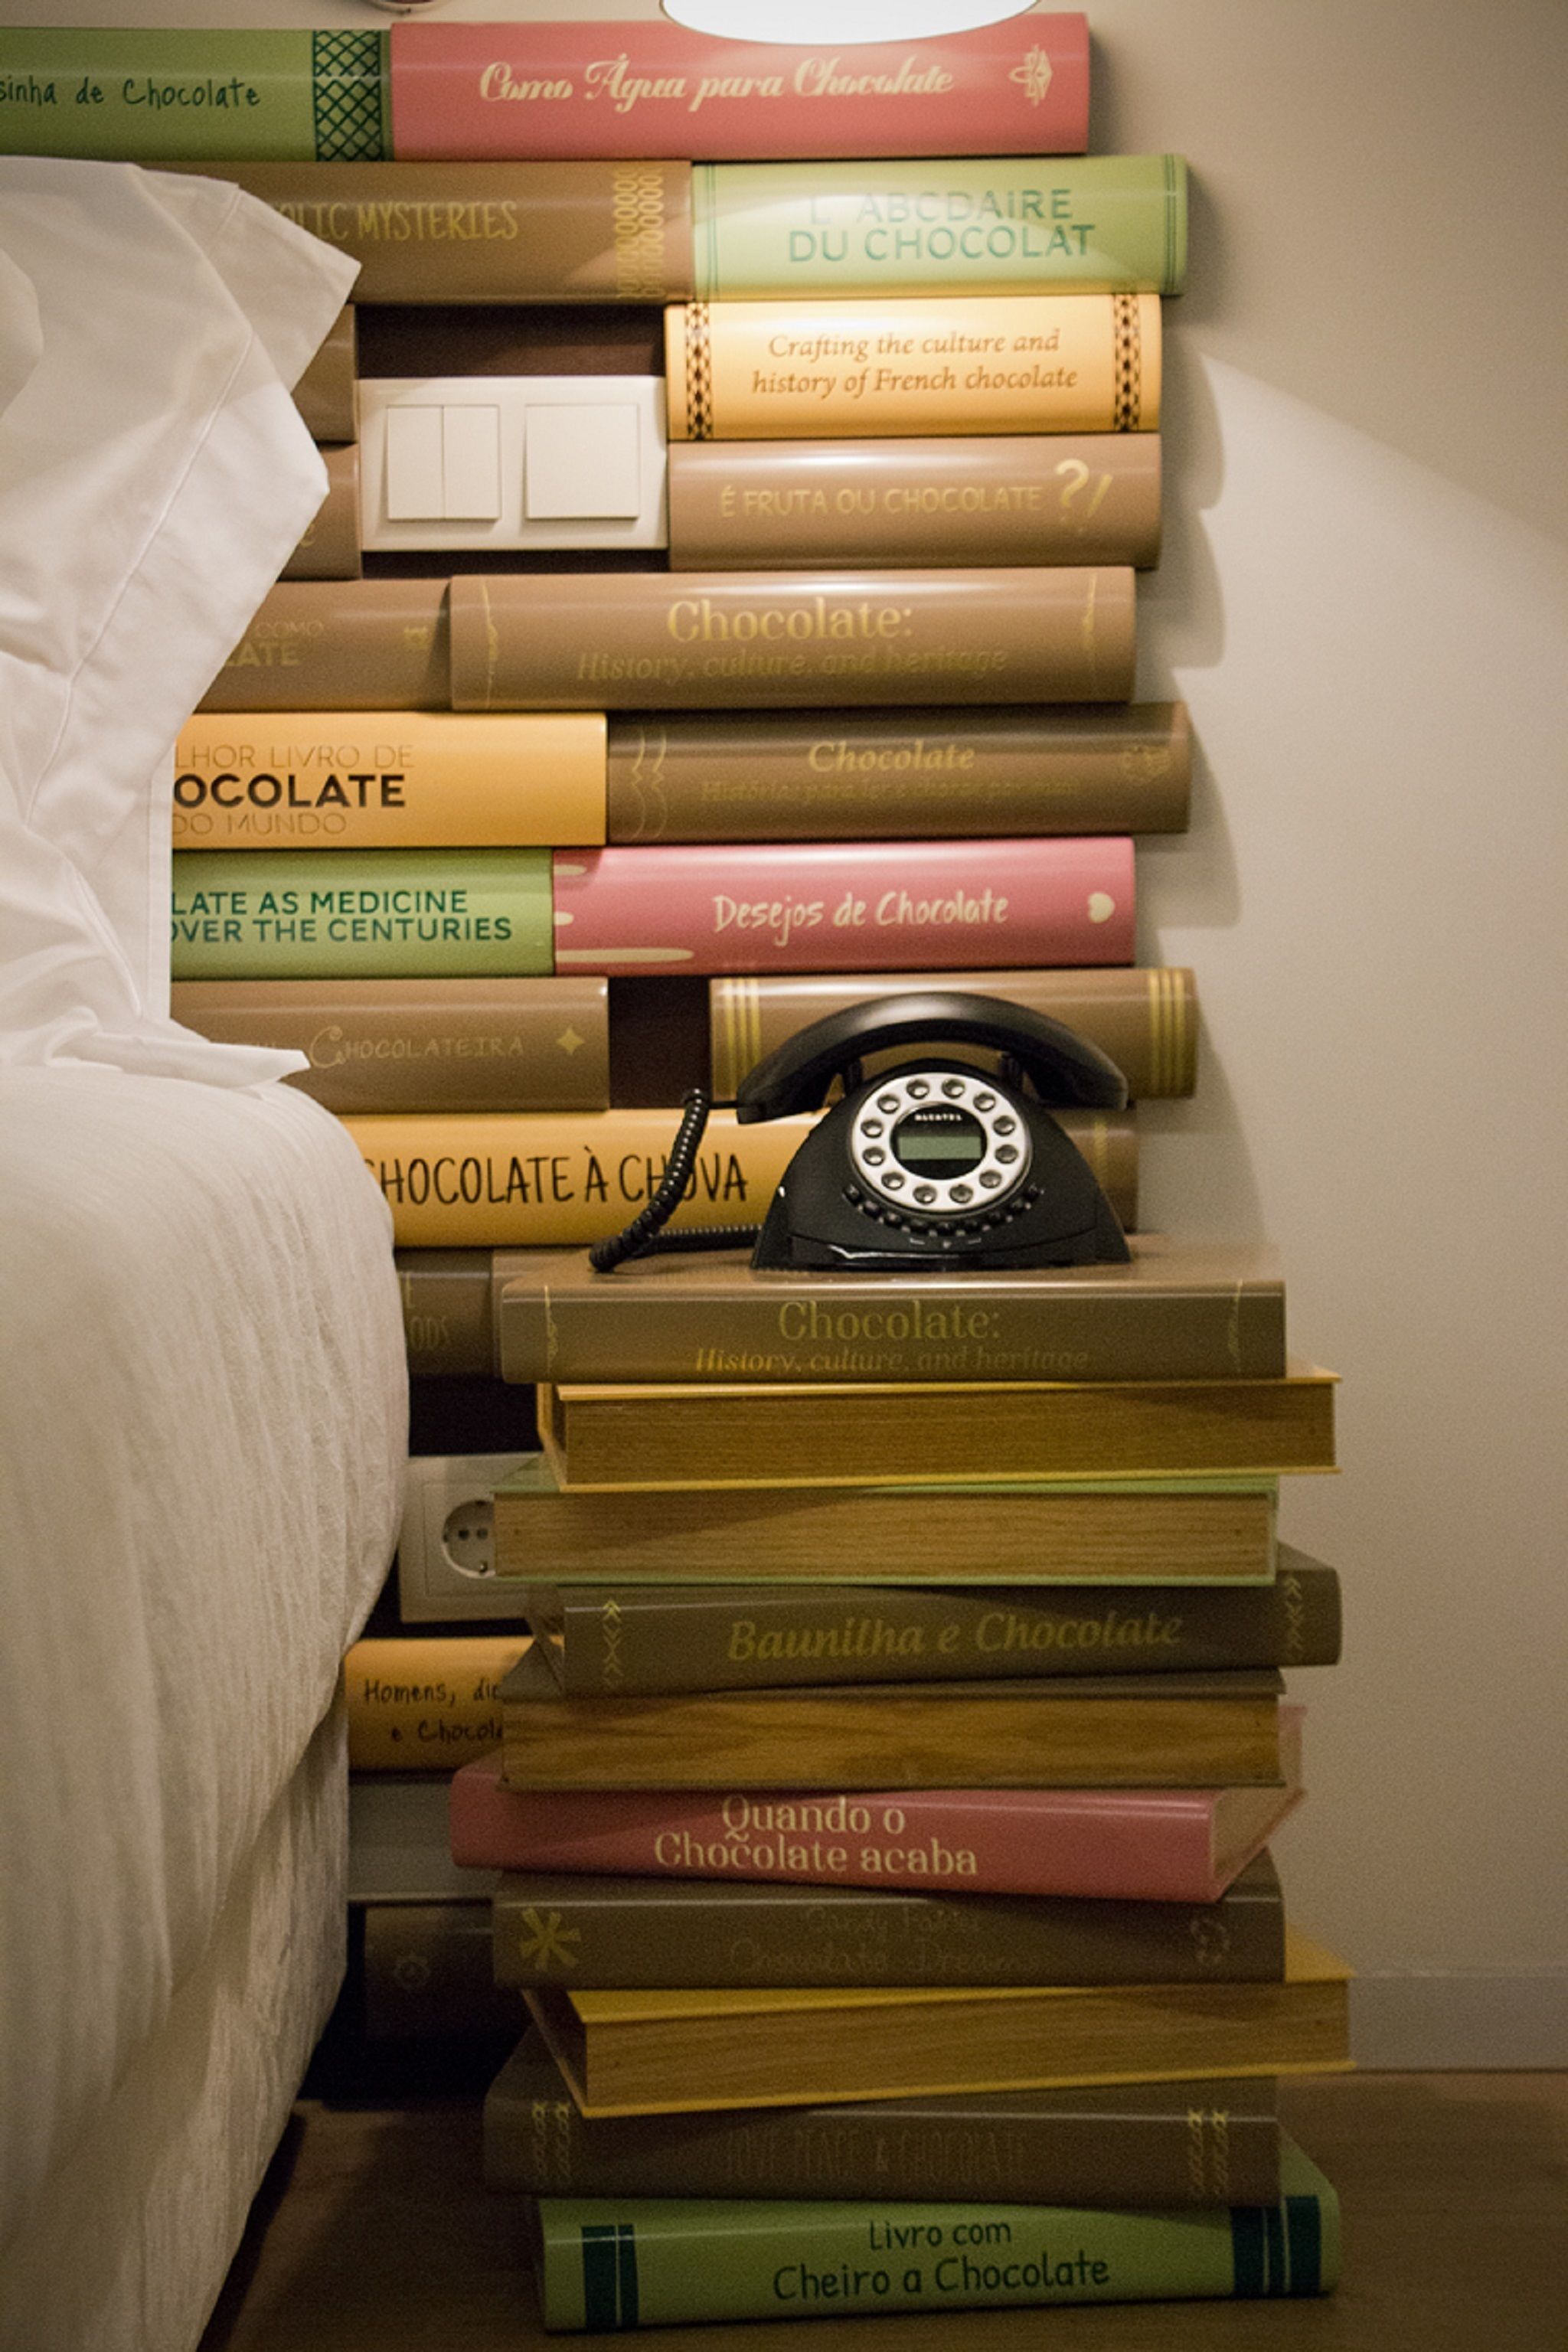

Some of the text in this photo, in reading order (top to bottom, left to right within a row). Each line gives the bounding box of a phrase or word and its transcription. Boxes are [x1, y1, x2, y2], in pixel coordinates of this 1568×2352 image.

[77, 77, 104, 104] de
[122, 77, 261, 109] Chocolate
[480, 54, 955, 113] Como Água para Chocolate
[358, 201, 518, 241] MYSTERIES
[789, 225, 1095, 263] DU CHOCOLAT
[768, 328, 1060, 361] Crafting the culture and
[752, 365, 1077, 399] history of French chocolate
[720, 485, 735, 517] É
[743, 489, 829, 517] FRUTA
[836, 488, 876, 515] OU
[884, 486, 1044, 514] CHOCOLATE
[254, 619, 325, 639] COMO
[668, 598, 913, 644] Chocolate:
[822, 646, 879, 675] and
[887, 645, 1008, 681] heritage
[175, 744, 413, 768] LHOR LIVRO DE
[808, 740, 975, 772] Chocolate
[174, 773, 406, 808] OCOLATE
[172, 812, 347, 835] DO MUNDO
[172, 890, 468, 915] LATE AS MEDICINE
[713, 888, 1009, 946] Desejos de Chocolate
[253, 919, 316, 942] THE
[328, 917, 512, 942] CENTURIES
[364, 1156, 576, 1205] HOCOLATE
[584, 1145, 609, 1203] À
[779, 1299, 1001, 1341] Chocolate:
[695, 1346, 802, 1374] History,
[920, 1346, 967, 1370] and
[974, 1345, 1089, 1371] heritage
[727, 1611, 1185, 1664] Baunilha e Chocolate
[364, 1677, 456, 1708] Homens,
[391, 1726, 403, 1743] e
[722, 1795, 905, 1841] Quando o
[655, 1831, 978, 1877] Chocolate acaba
[871, 2220, 1013, 2252] Livro com
[774, 2249, 1111, 2300] Cheiro a Chocolate
